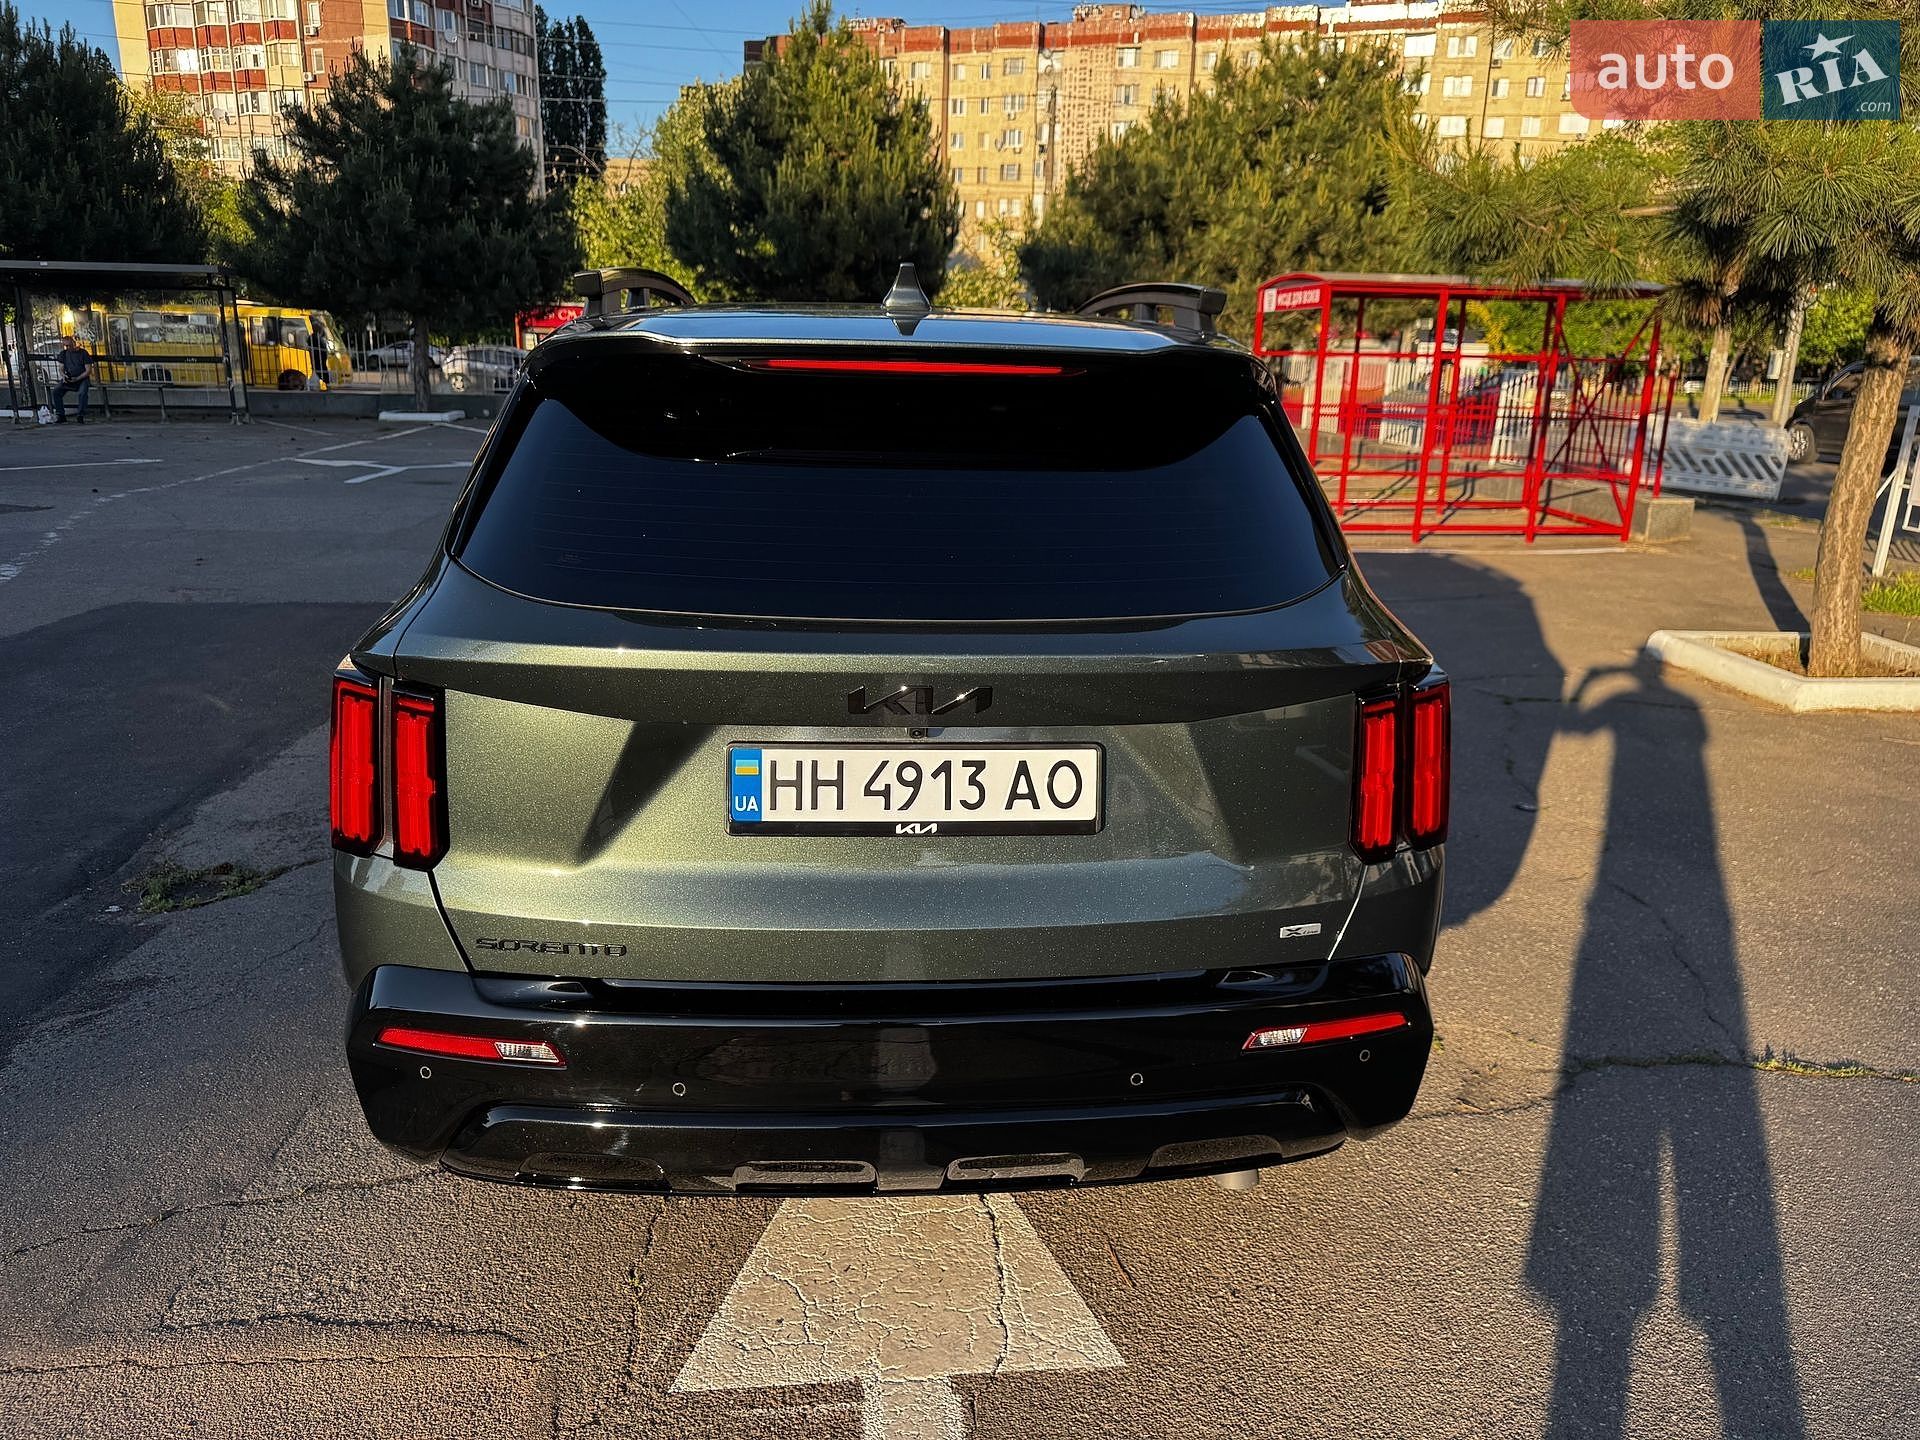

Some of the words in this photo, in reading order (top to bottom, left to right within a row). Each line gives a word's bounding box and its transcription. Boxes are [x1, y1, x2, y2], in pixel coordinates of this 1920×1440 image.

[769, 759, 844, 811] HH
[863, 759, 987, 811] 4913
[1004, 759, 1083, 811] AO
[735, 796, 759, 812] UA
[475, 938, 627, 957] SORENTO
